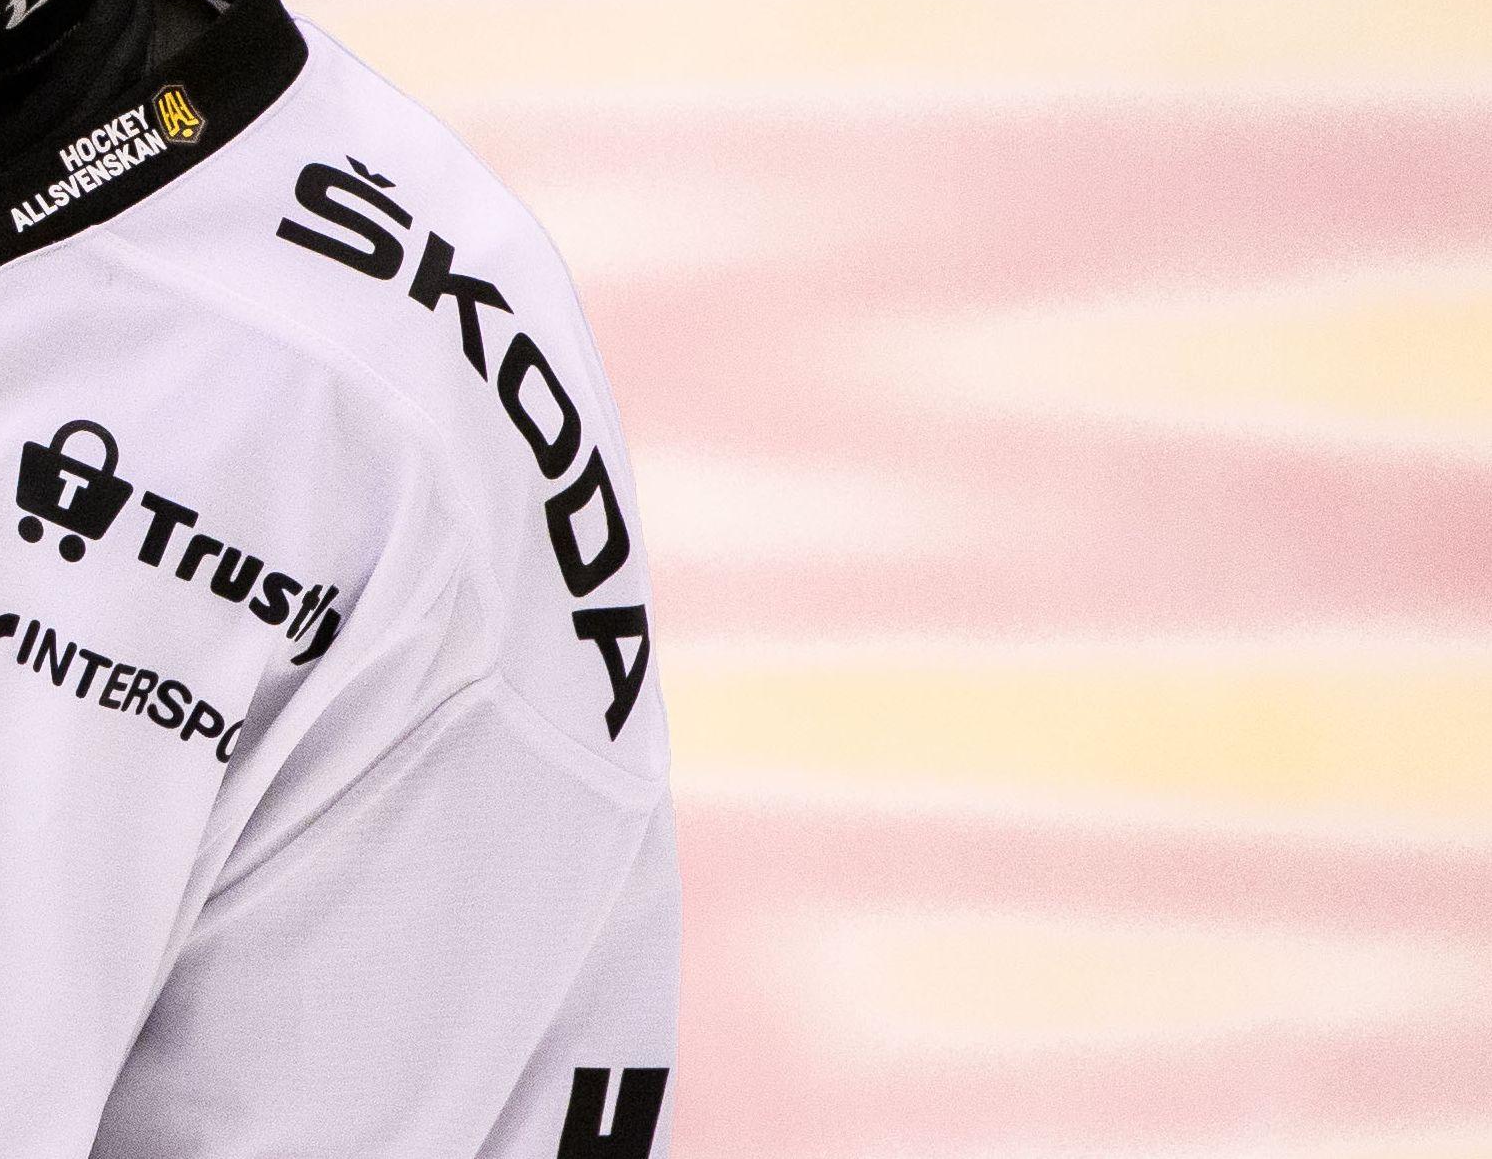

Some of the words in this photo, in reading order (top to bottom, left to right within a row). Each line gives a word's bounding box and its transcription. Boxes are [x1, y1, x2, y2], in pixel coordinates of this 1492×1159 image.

[9, 128, 168, 233] ALLSVENSKAN
[59, 104, 149, 172] HOCKEY
[275, 154, 650, 742] ŠKODA
[137, 490, 342, 666] Trustly
